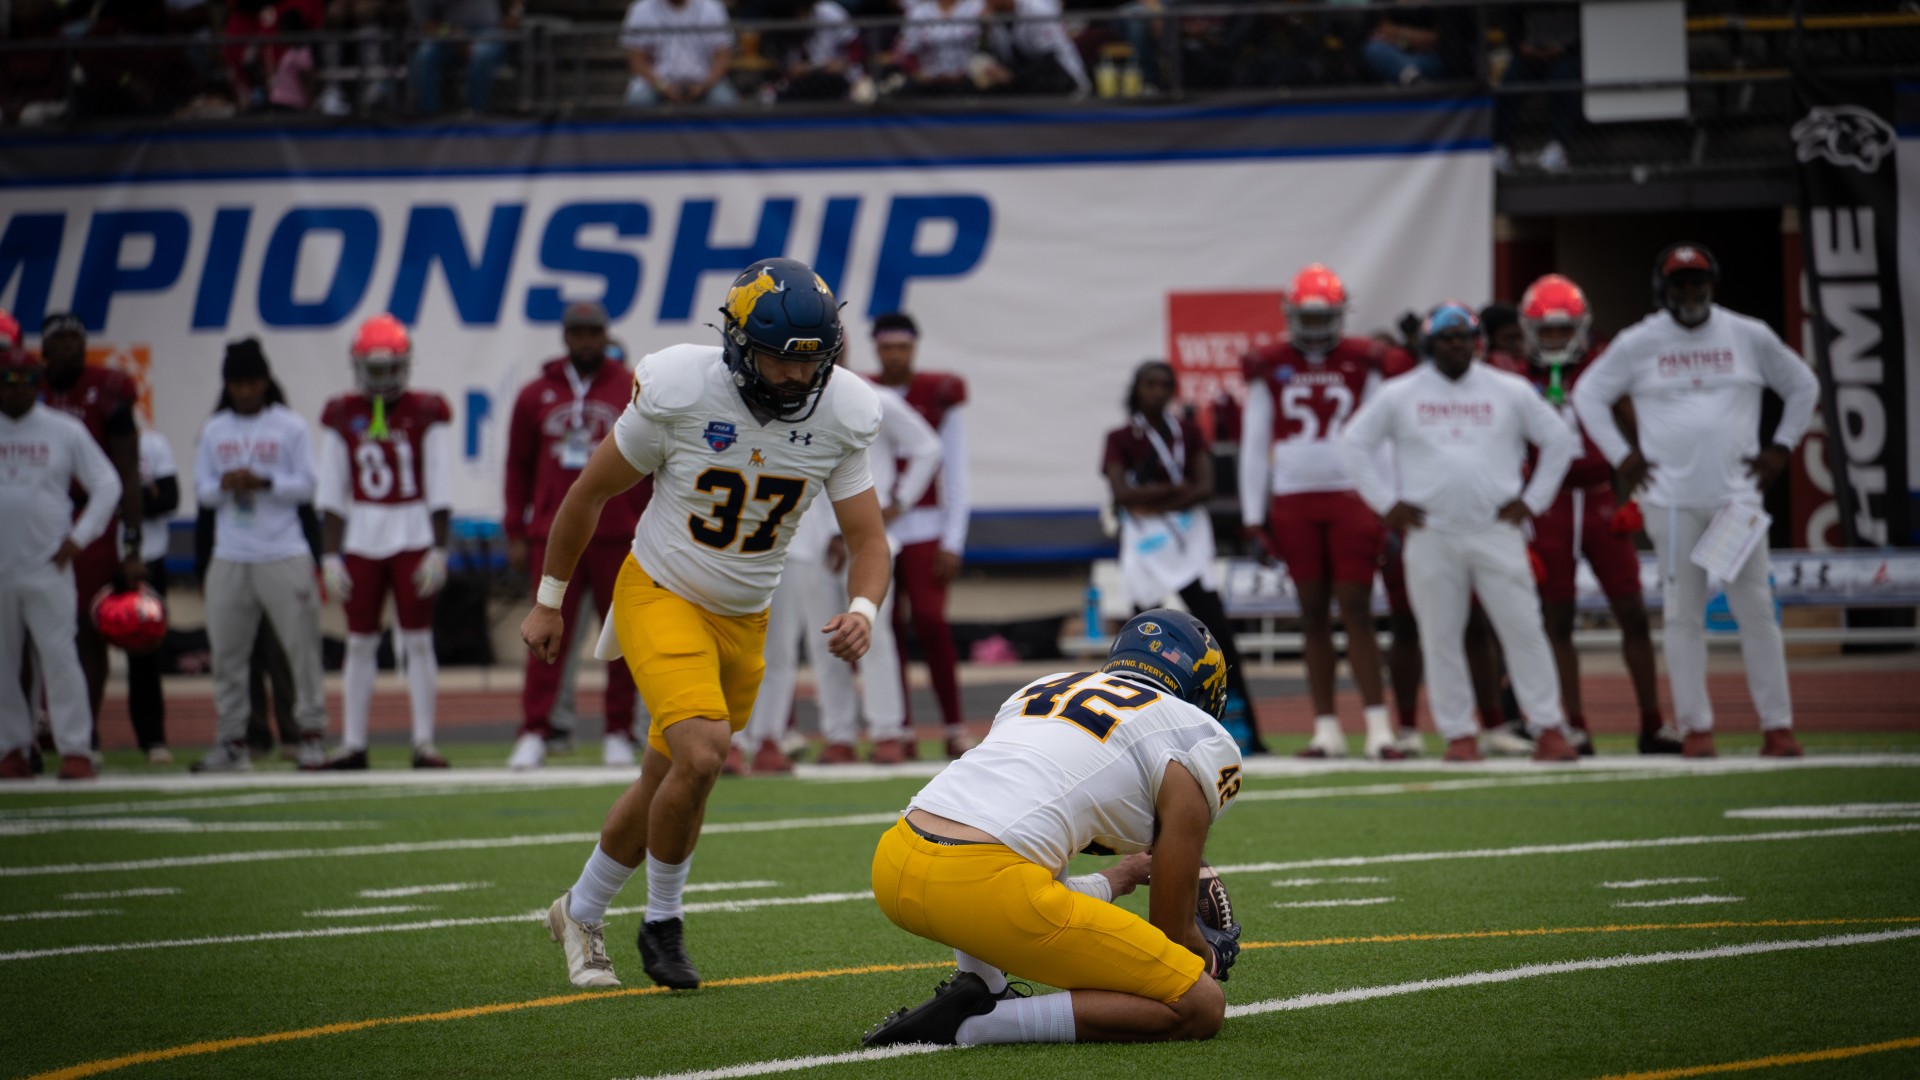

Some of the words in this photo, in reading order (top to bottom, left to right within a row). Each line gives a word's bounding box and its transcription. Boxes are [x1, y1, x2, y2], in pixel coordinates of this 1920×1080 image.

[793, 341, 819, 351] JCSU
[1281, 386, 1354, 442] 52
[355, 440, 417, 500] 81
[688, 467, 808, 554] 37
[1149, 640, 1161, 653] 42
[1138, 662, 1164, 679] EVERY
[1163, 675, 1179, 691] DAY
[1017, 671, 1162, 744] 42
[1216, 764, 1242, 809] 42
